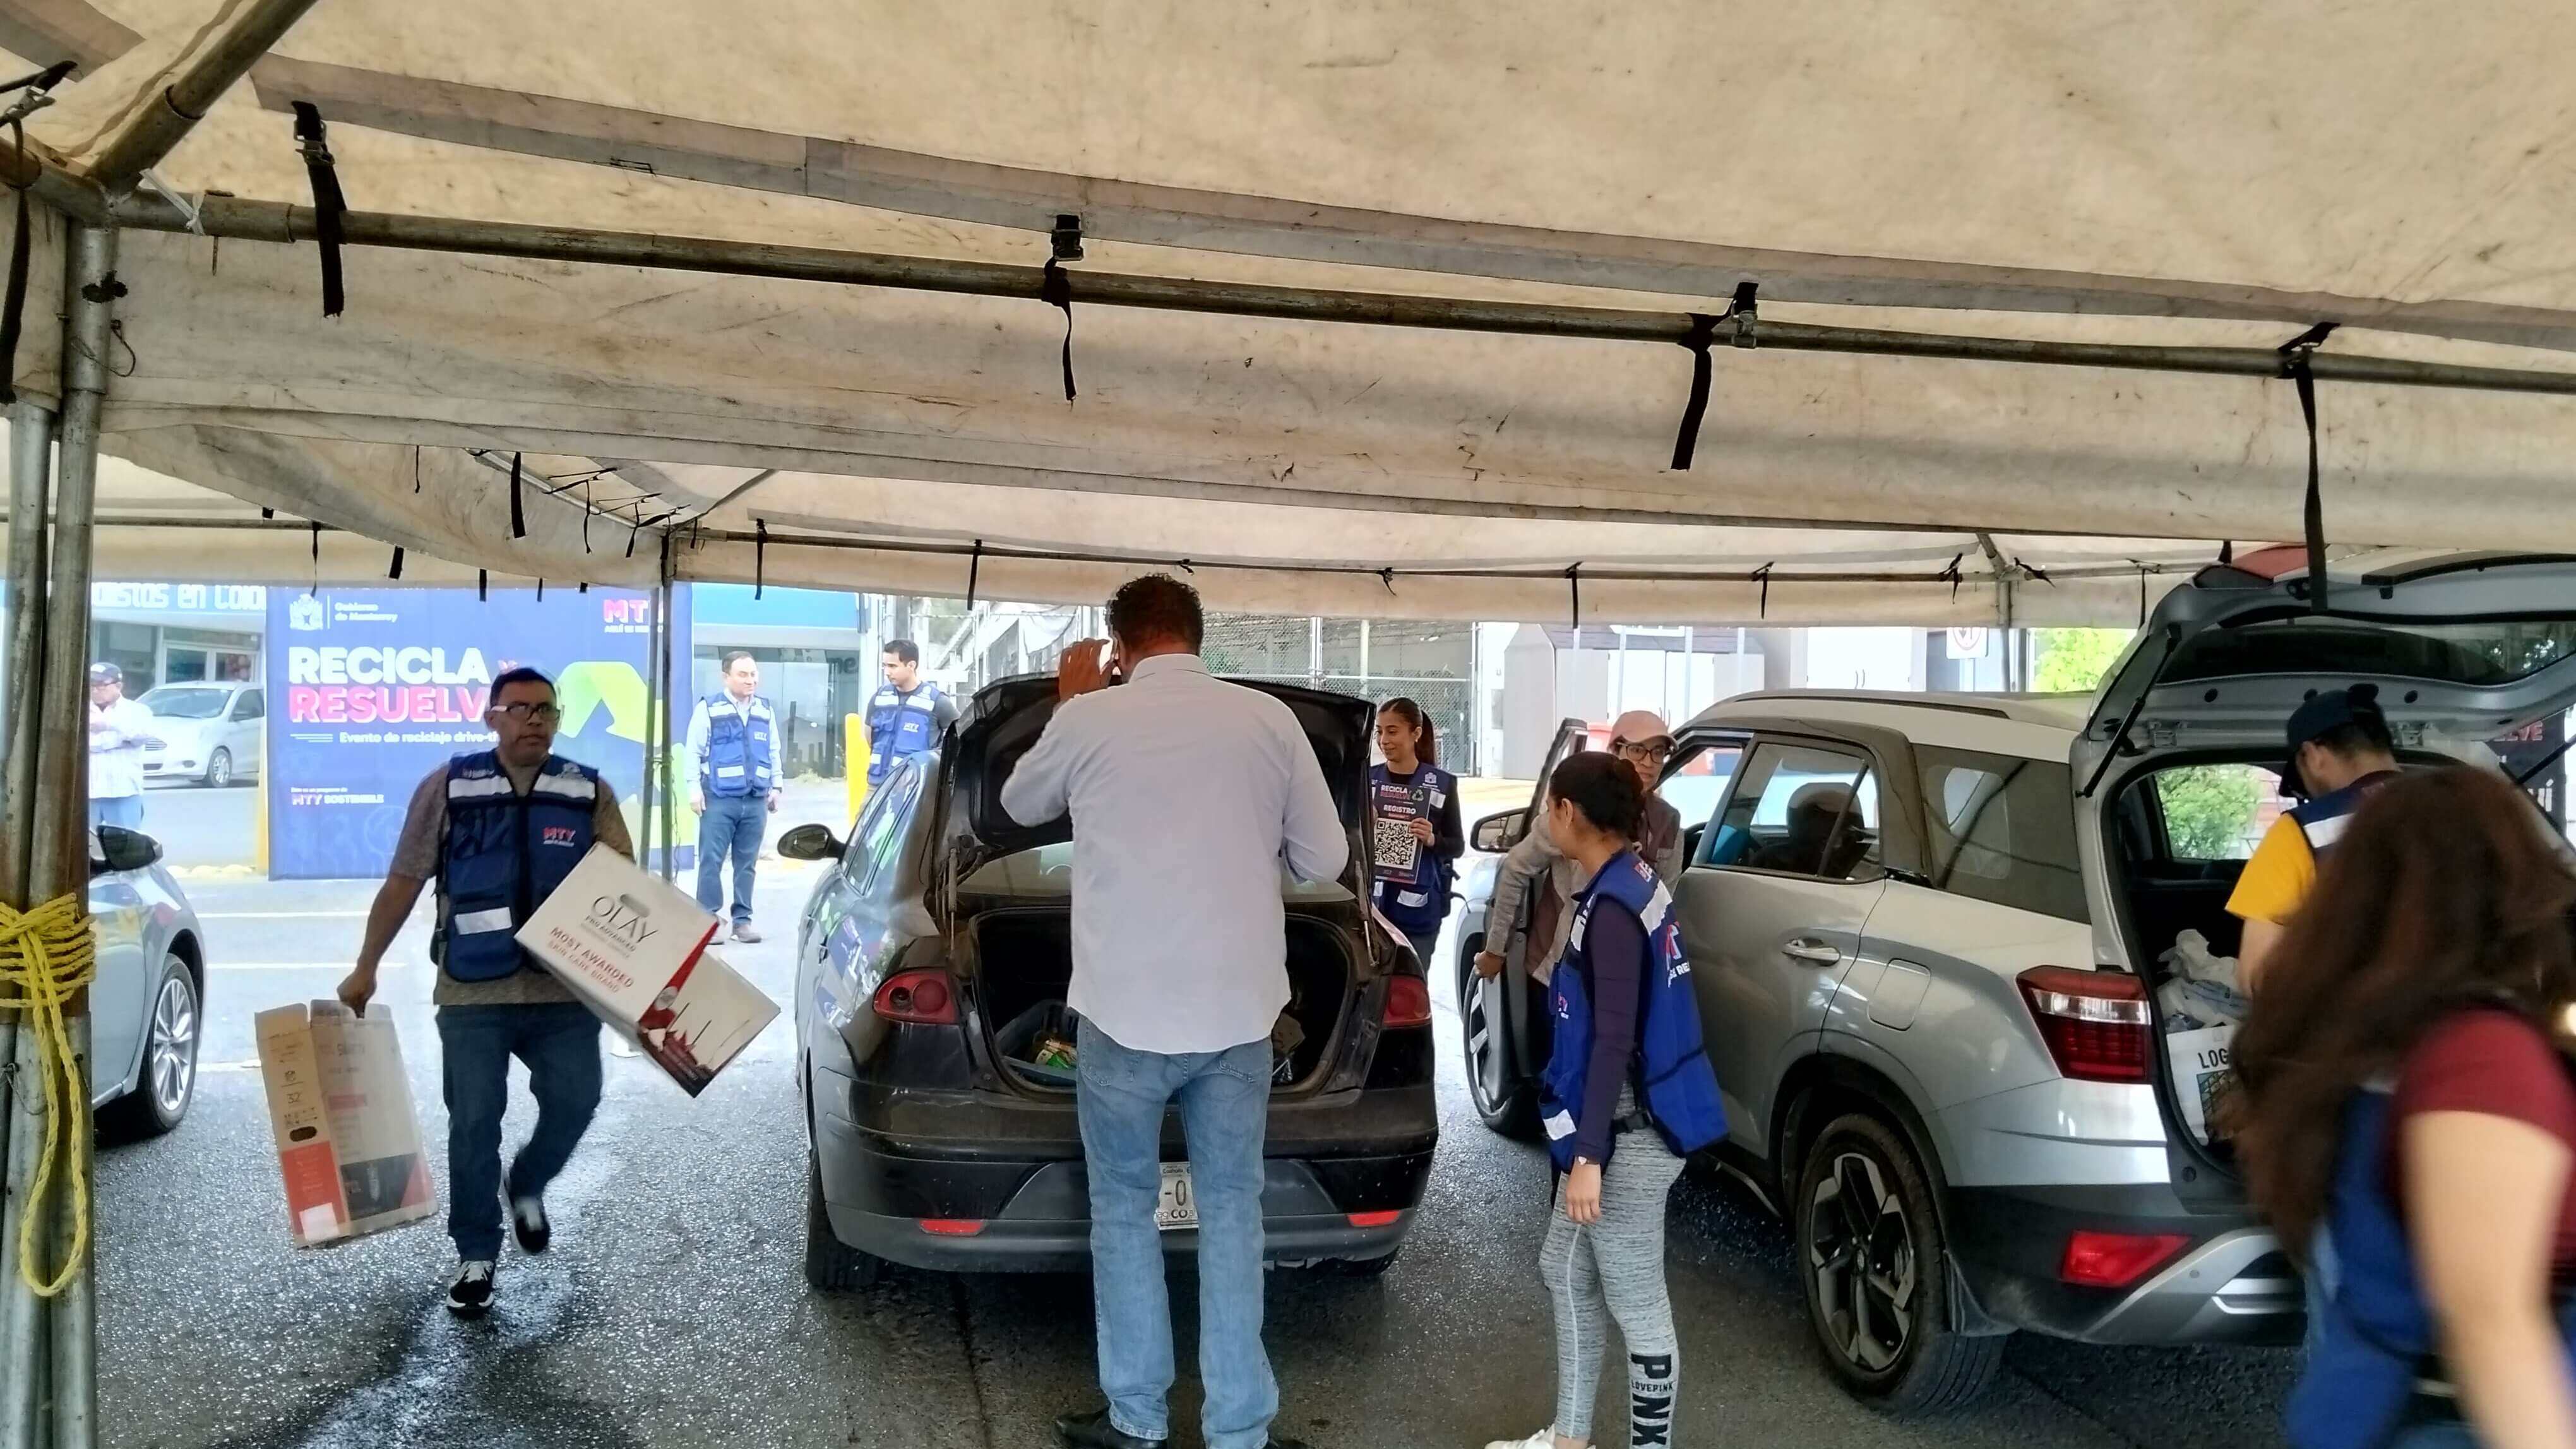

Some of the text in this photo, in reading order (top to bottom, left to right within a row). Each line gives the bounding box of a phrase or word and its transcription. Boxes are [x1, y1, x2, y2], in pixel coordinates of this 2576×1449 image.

[289, 646, 491, 684] RECICLA
[289, 686, 491, 724] RESUELV
[340, 732, 381, 742] Evento
[384, 732, 400, 742] de
[402, 732, 451, 744] reciclaje
[1381, 785, 1409, 794] RECICLA
[1383, 804, 1417, 815] REGISTRO
[542, 826, 576, 841] MTY
[592, 895, 659, 943] OLAY
[551, 926, 582, 951] MOST
[581, 949, 634, 987] AWARDED
